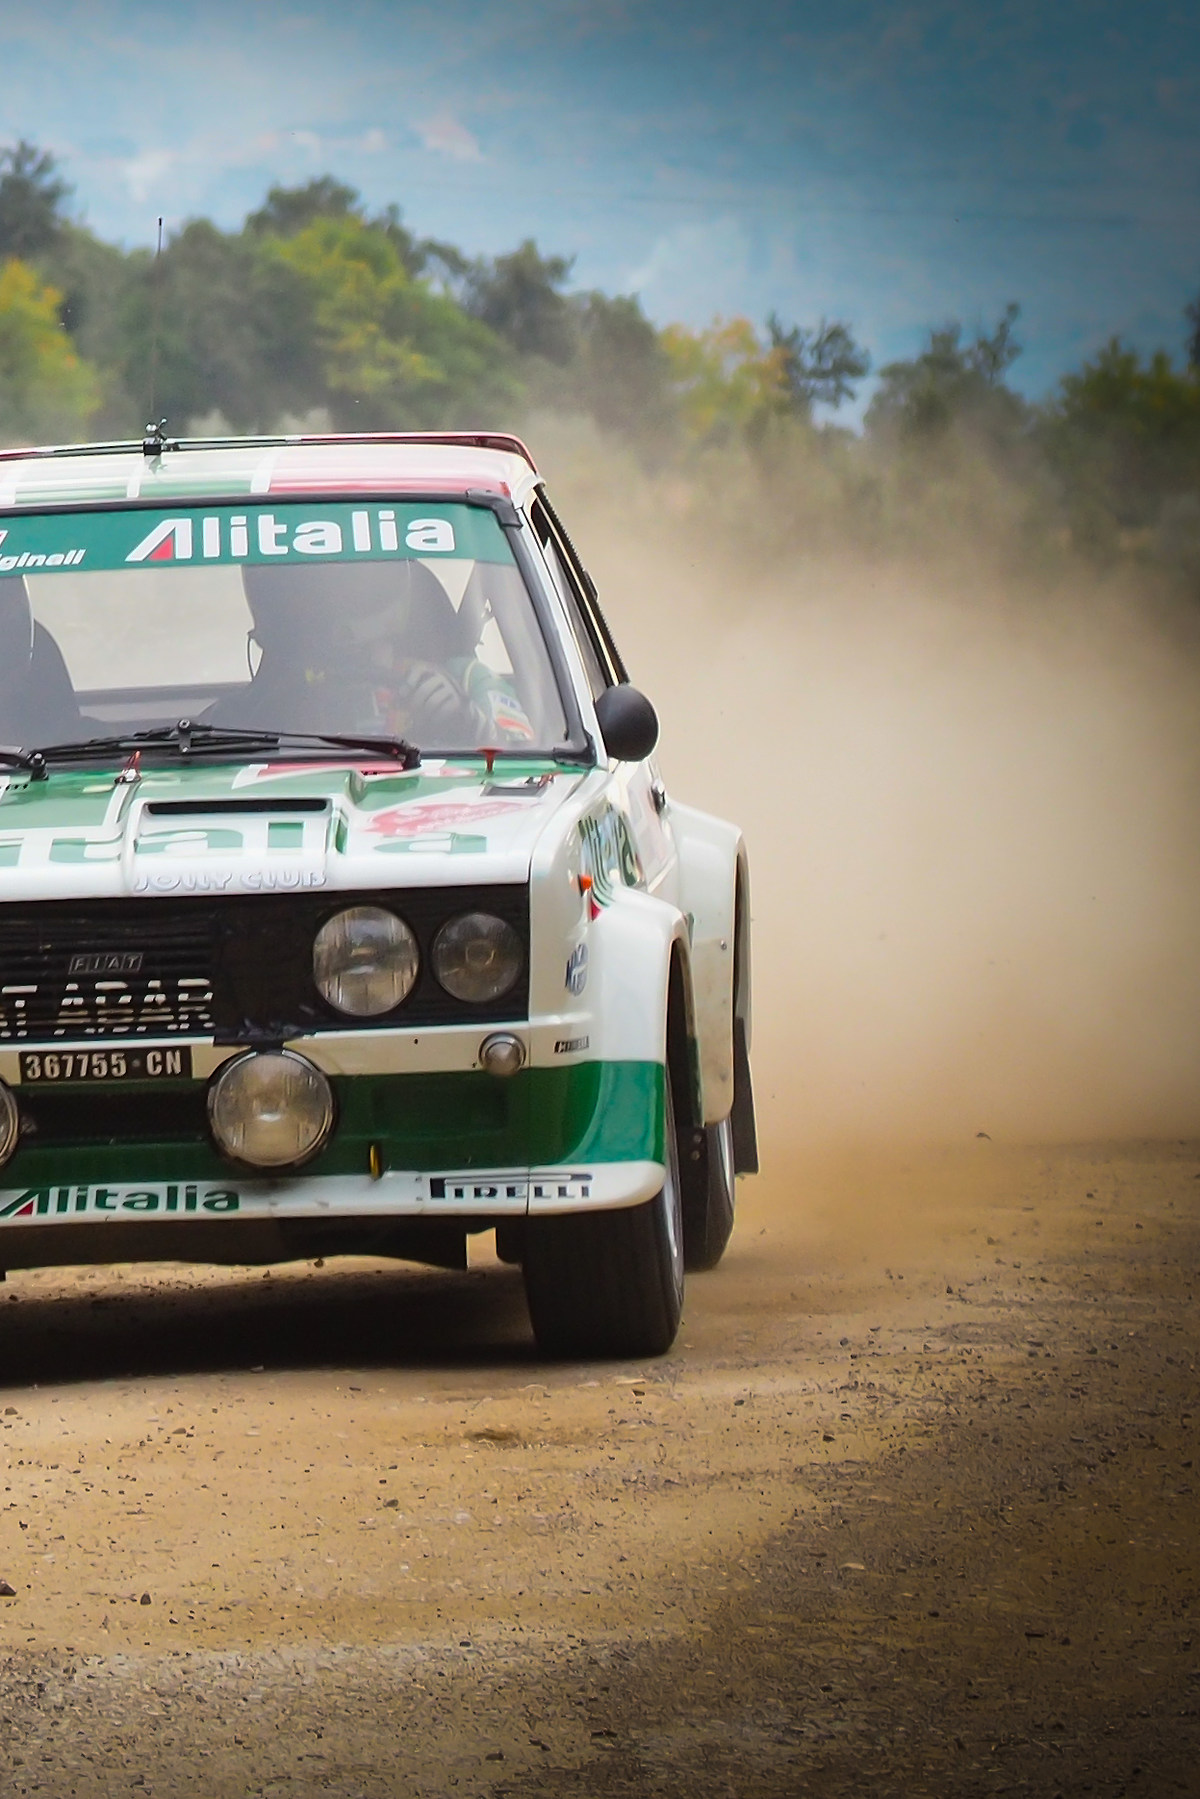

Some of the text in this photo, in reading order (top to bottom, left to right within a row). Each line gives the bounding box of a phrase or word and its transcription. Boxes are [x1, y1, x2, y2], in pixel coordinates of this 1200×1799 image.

[125, 510, 456, 562] Alitalia
[134, 868, 328, 893] JOLLY CLUB
[69, 953, 143, 974] FIAT
[25, 1049, 183, 1080] 367755 CN
[429, 1172, 593, 1200] PIRELLI
